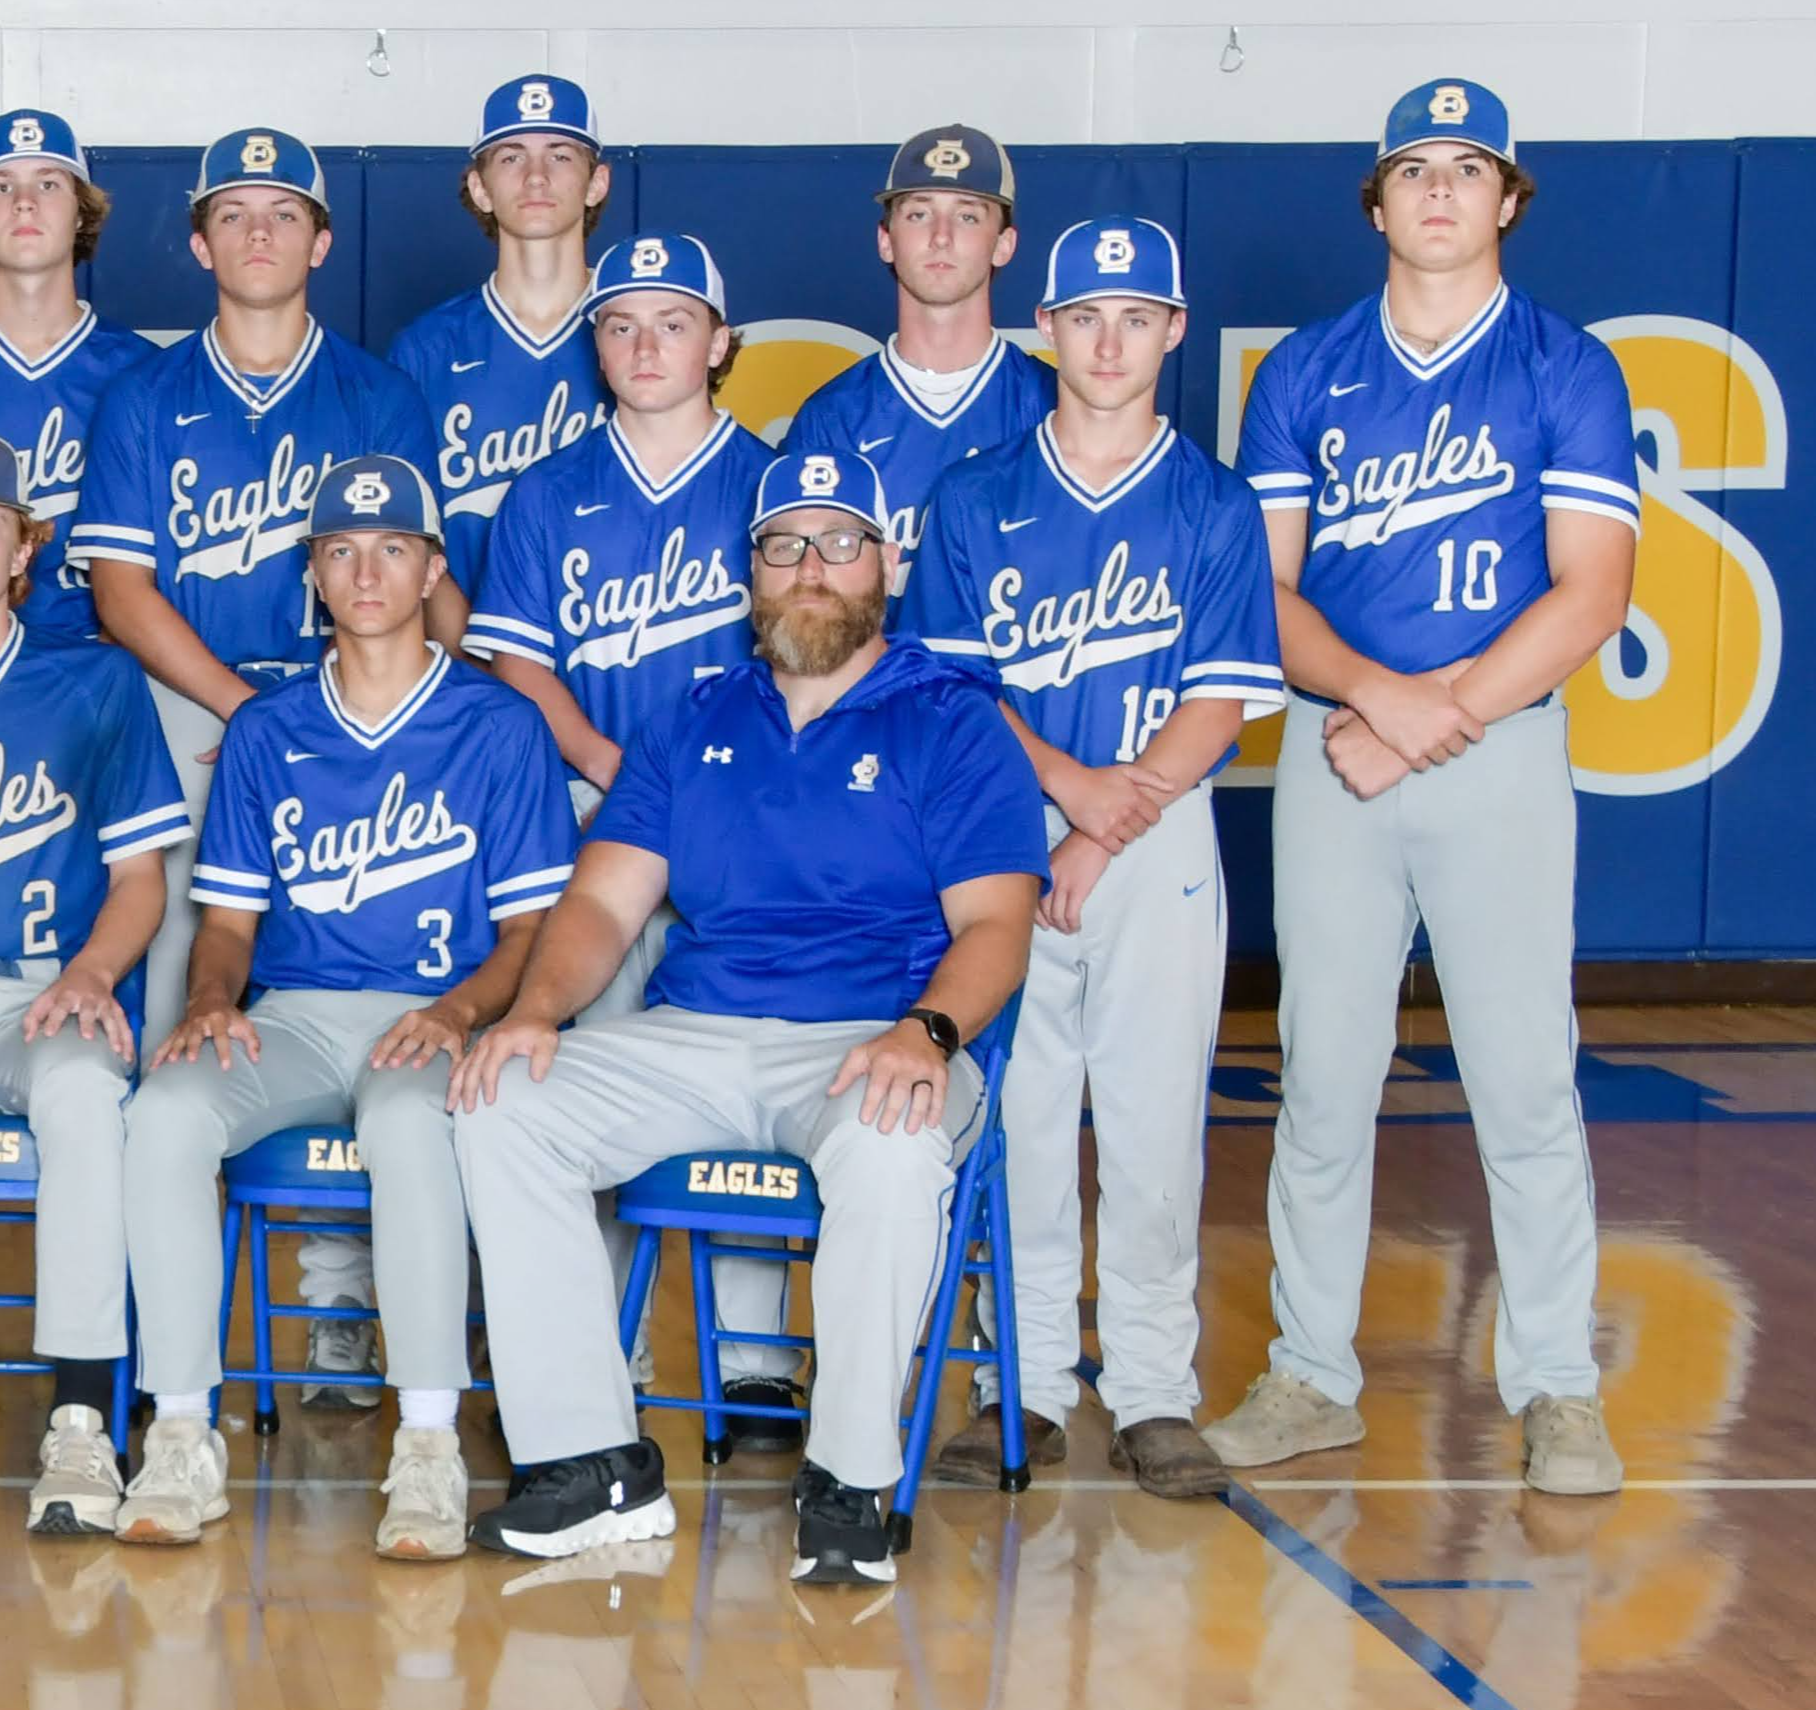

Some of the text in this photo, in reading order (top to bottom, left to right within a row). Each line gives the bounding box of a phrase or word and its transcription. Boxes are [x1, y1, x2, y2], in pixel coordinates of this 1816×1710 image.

[1317, 403, 1515, 546] Eagles
[559, 526, 752, 668] Eagles
[982, 540, 1183, 688] Eagles
[1433, 539, 1502, 612] 10
[1115, 685, 1176, 763] 18
[271, 771, 477, 914] Eagles
[21, 879, 58, 956] 2
[416, 908, 453, 978] 3
[687, 1161, 799, 1200] EAGLES
